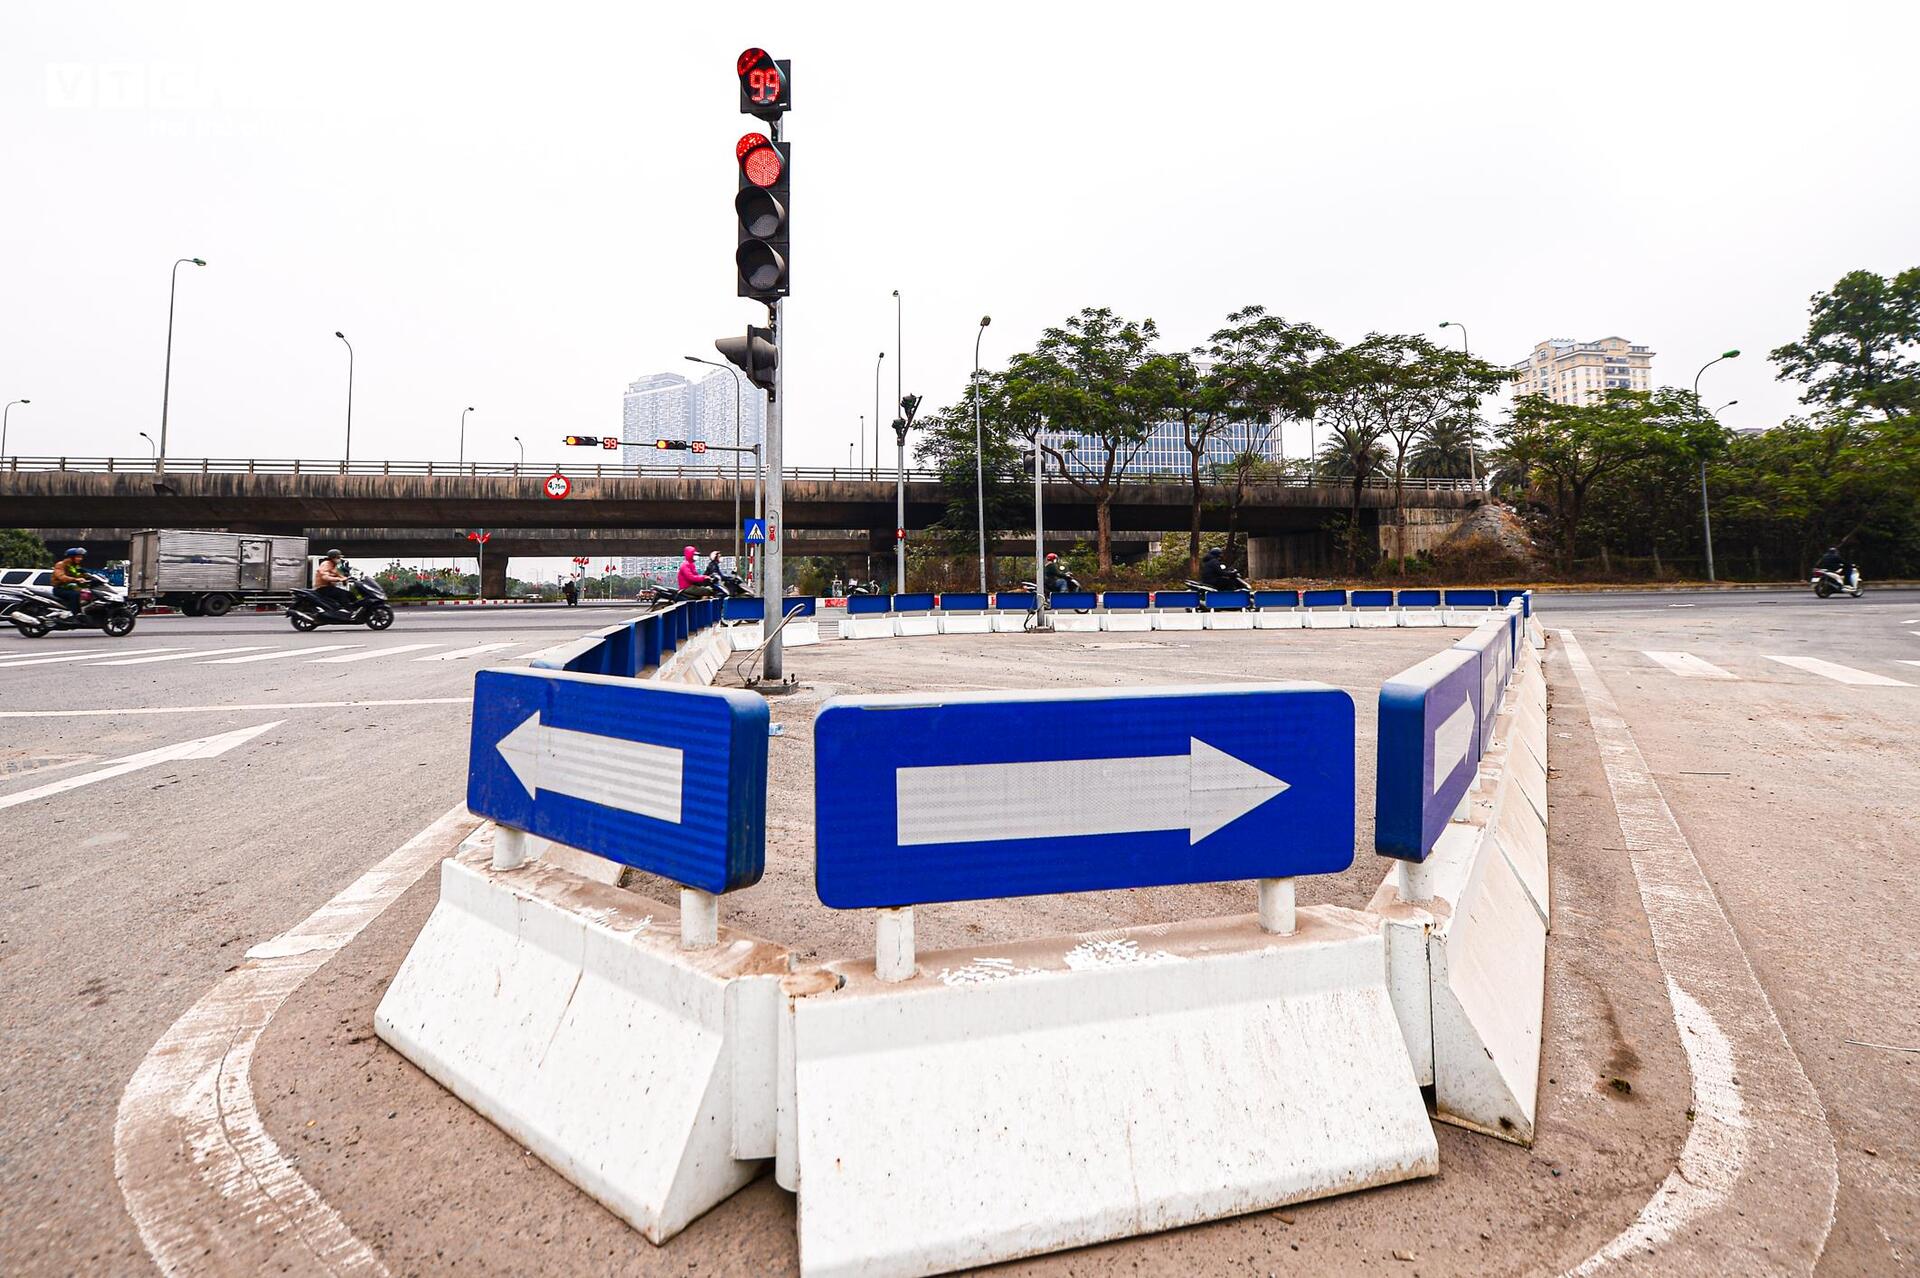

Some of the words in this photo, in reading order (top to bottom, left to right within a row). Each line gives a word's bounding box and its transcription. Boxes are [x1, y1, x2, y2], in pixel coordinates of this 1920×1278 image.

[751, 69, 780, 102] 99
[603, 439, 617, 449] 99
[692, 442, 705, 453] 99
